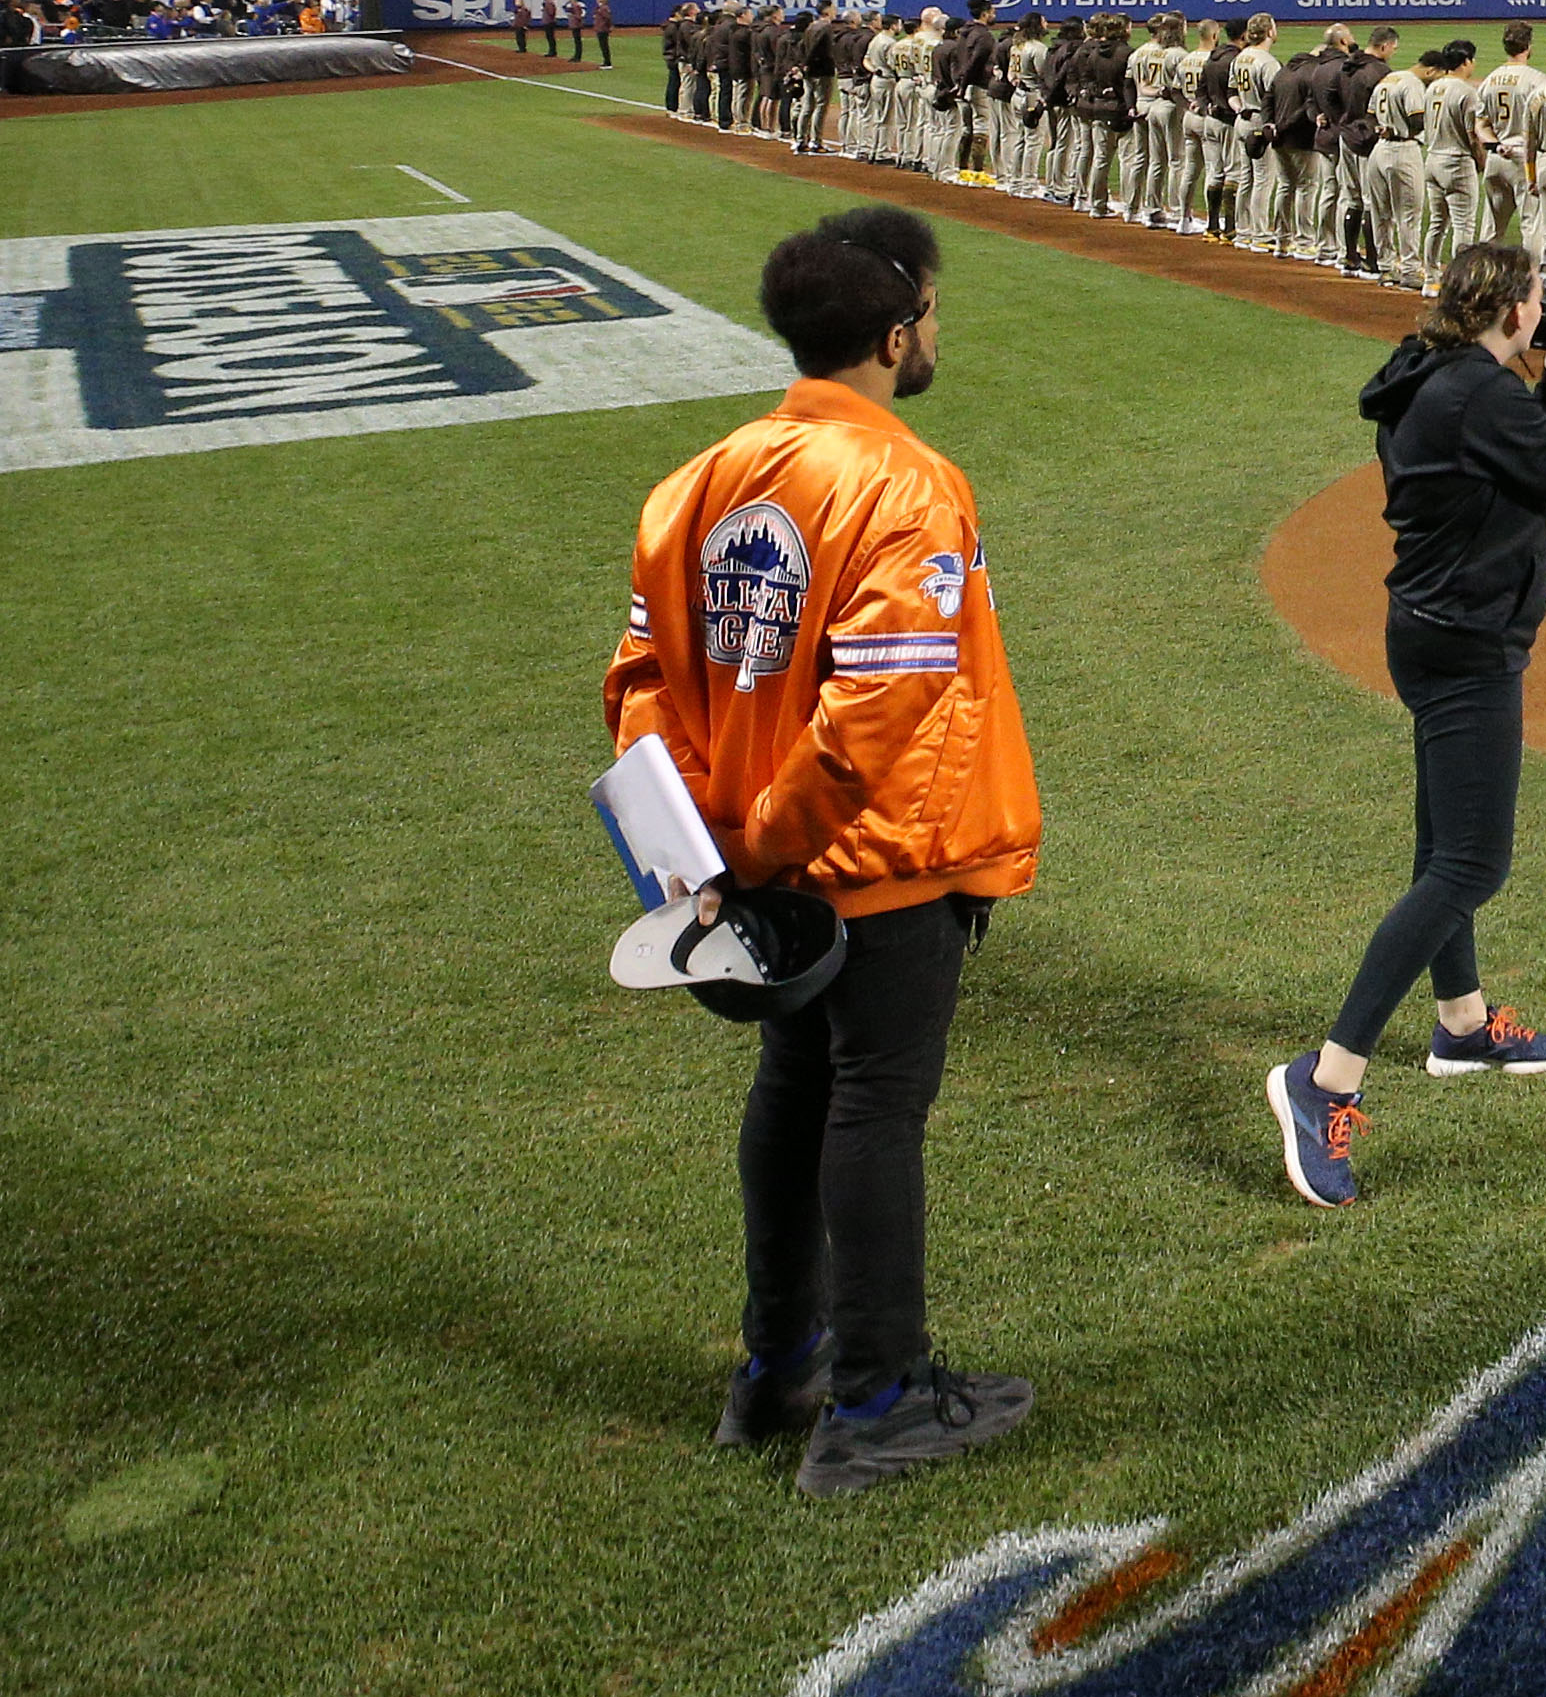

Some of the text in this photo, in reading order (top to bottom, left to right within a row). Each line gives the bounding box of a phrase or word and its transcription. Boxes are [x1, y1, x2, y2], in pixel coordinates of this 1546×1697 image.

[1490, 74, 1520, 87] MYERS
[1379, 87, 1388, 113] 2
[1498, 91, 1511, 120] 5
[1432, 101, 1443, 129] 7
[120, 232, 460, 418] POSTSEASON
